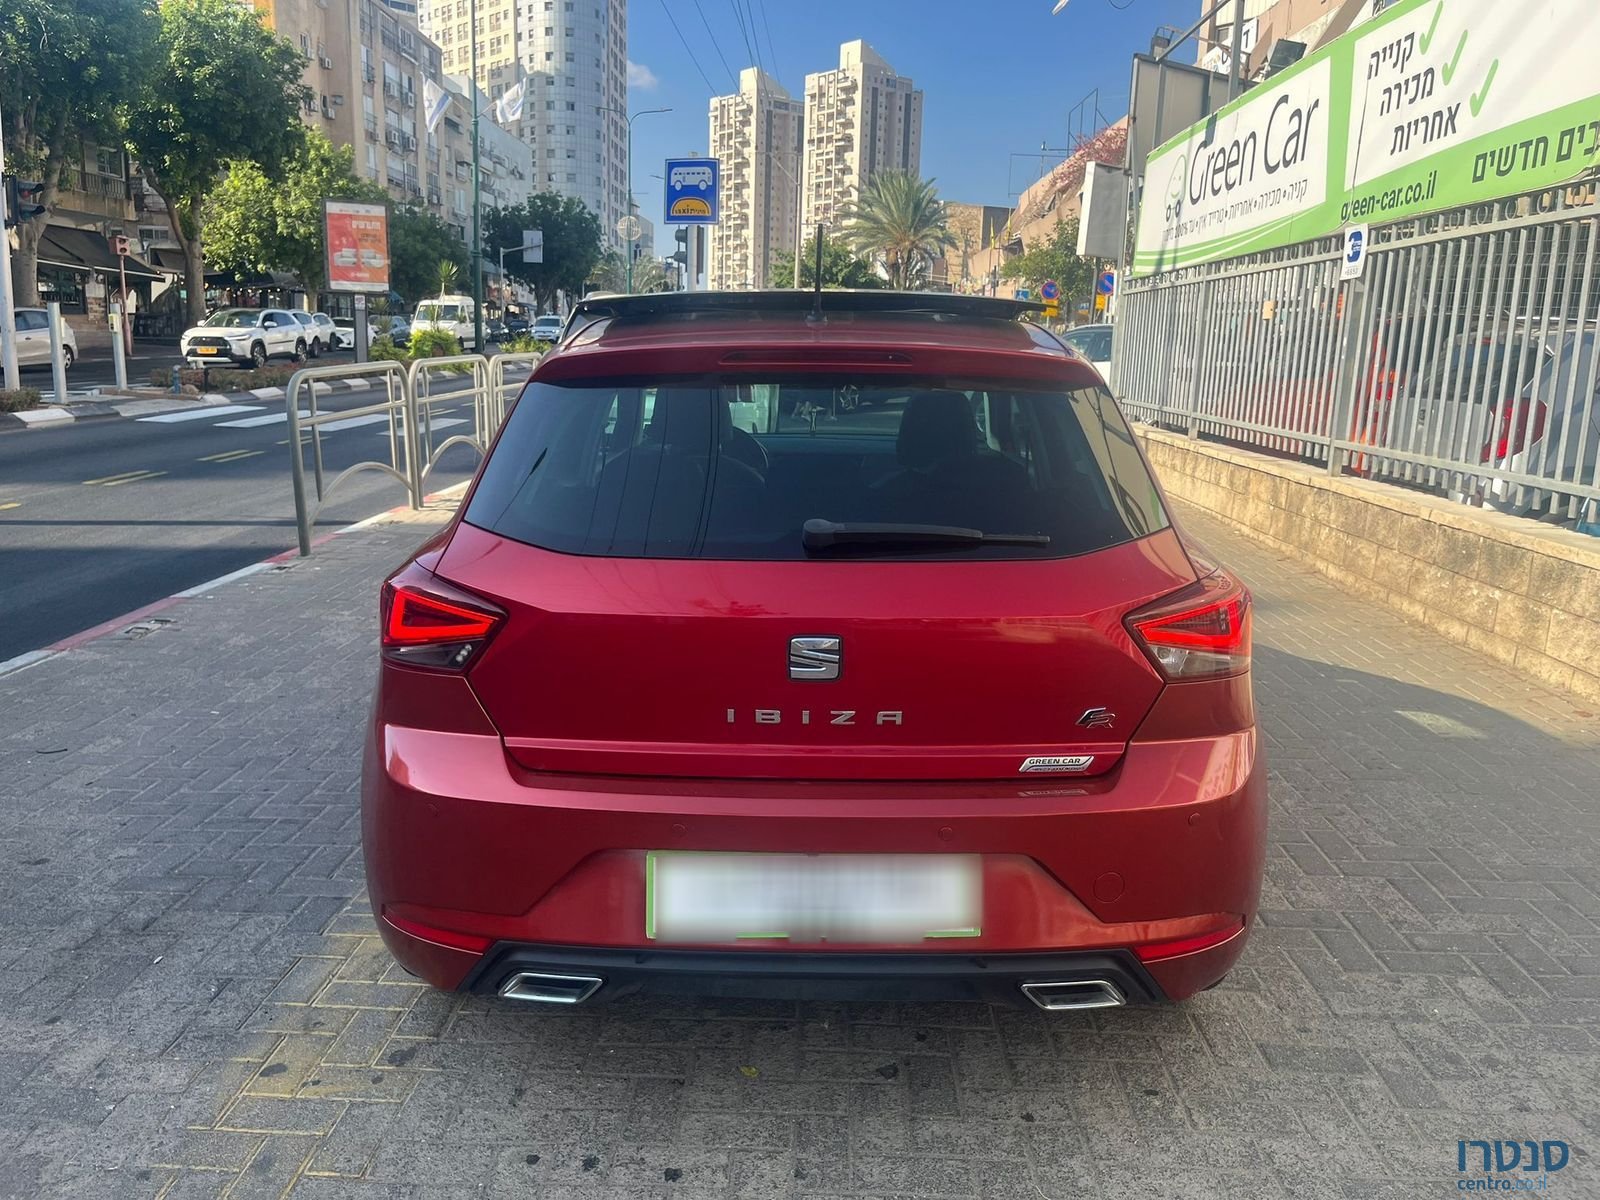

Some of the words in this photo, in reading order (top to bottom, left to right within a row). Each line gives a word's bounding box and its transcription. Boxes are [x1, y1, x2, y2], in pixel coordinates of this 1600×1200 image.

[1367, 31, 1415, 81] קנייה
[1379, 66, 1436, 117] מכירה
[1188, 131, 1257, 206] Green
[1264, 93, 1320, 175] Car
[1389, 101, 1462, 156] אחריות
[1471, 135, 1549, 184] חדשים
[1340, 169, 1438, 222] geen-car.co.il
[727, 708, 903, 726] IBIZA
[1075, 706, 1117, 729] FR
